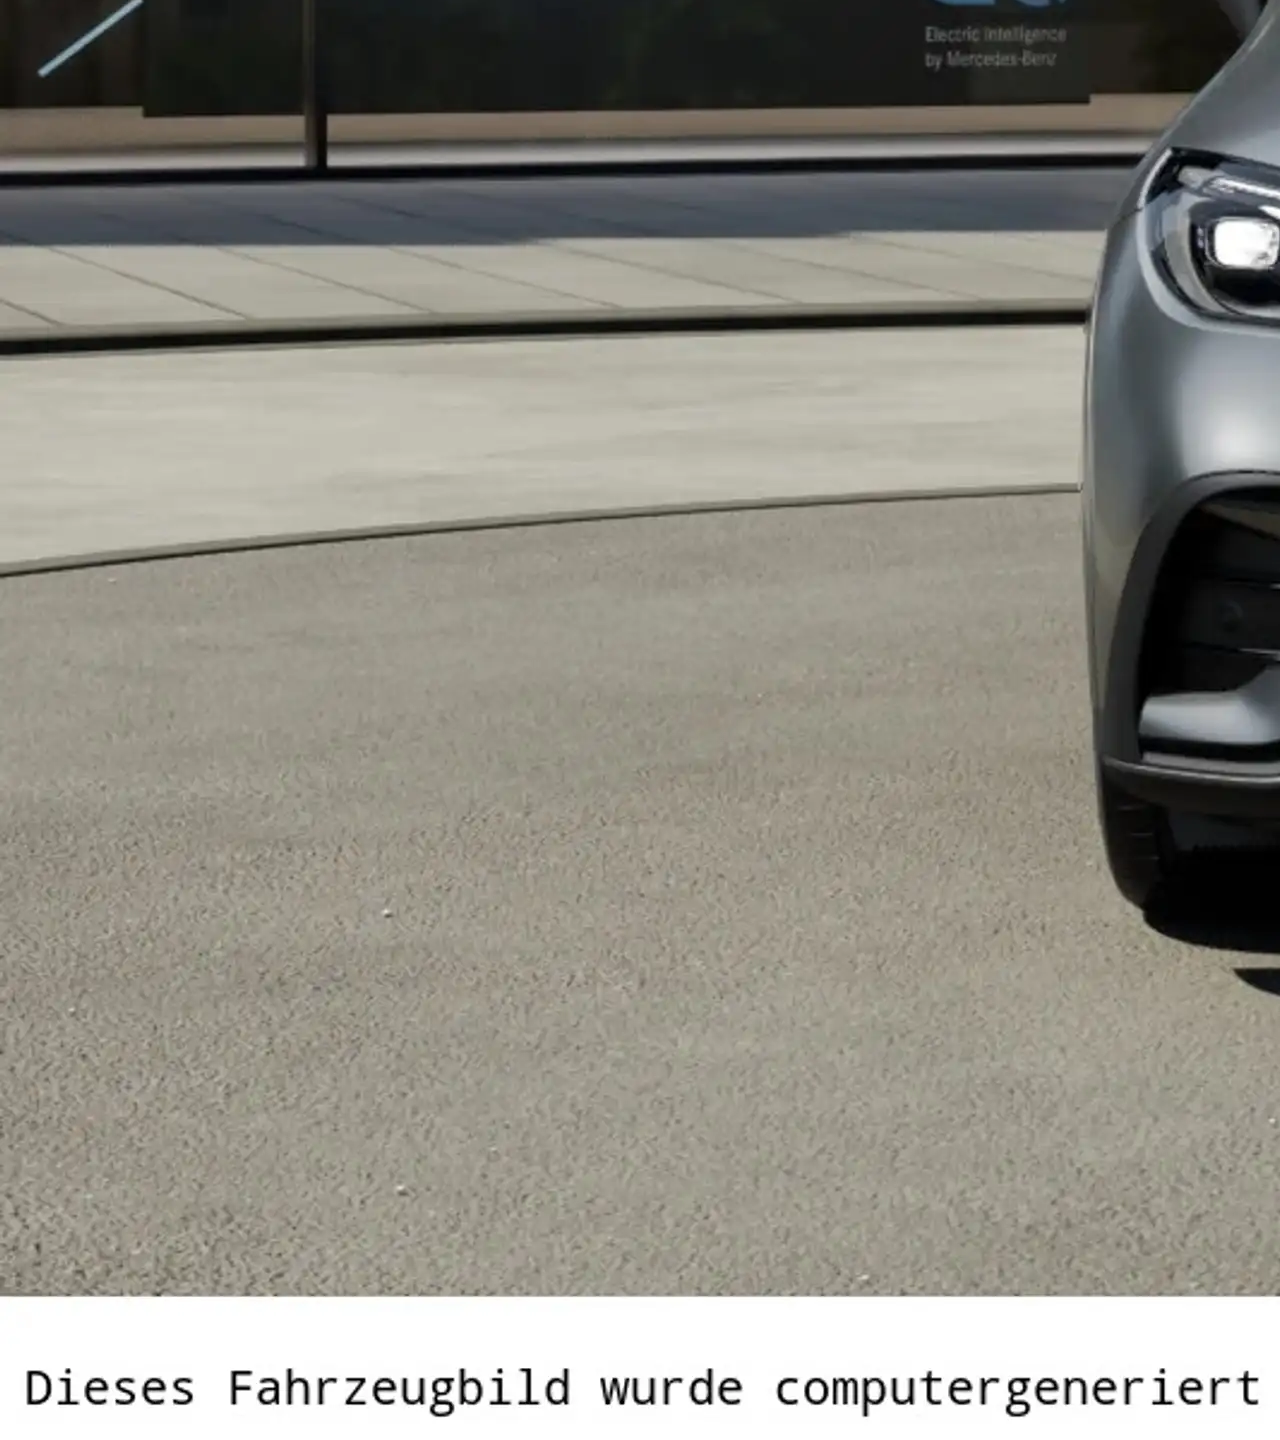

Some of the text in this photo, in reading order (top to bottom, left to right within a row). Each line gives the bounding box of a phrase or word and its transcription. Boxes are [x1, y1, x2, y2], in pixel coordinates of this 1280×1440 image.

[925, 25, 981, 42] Electric
[925, 49, 1057, 72] by Mercedes-Benz
